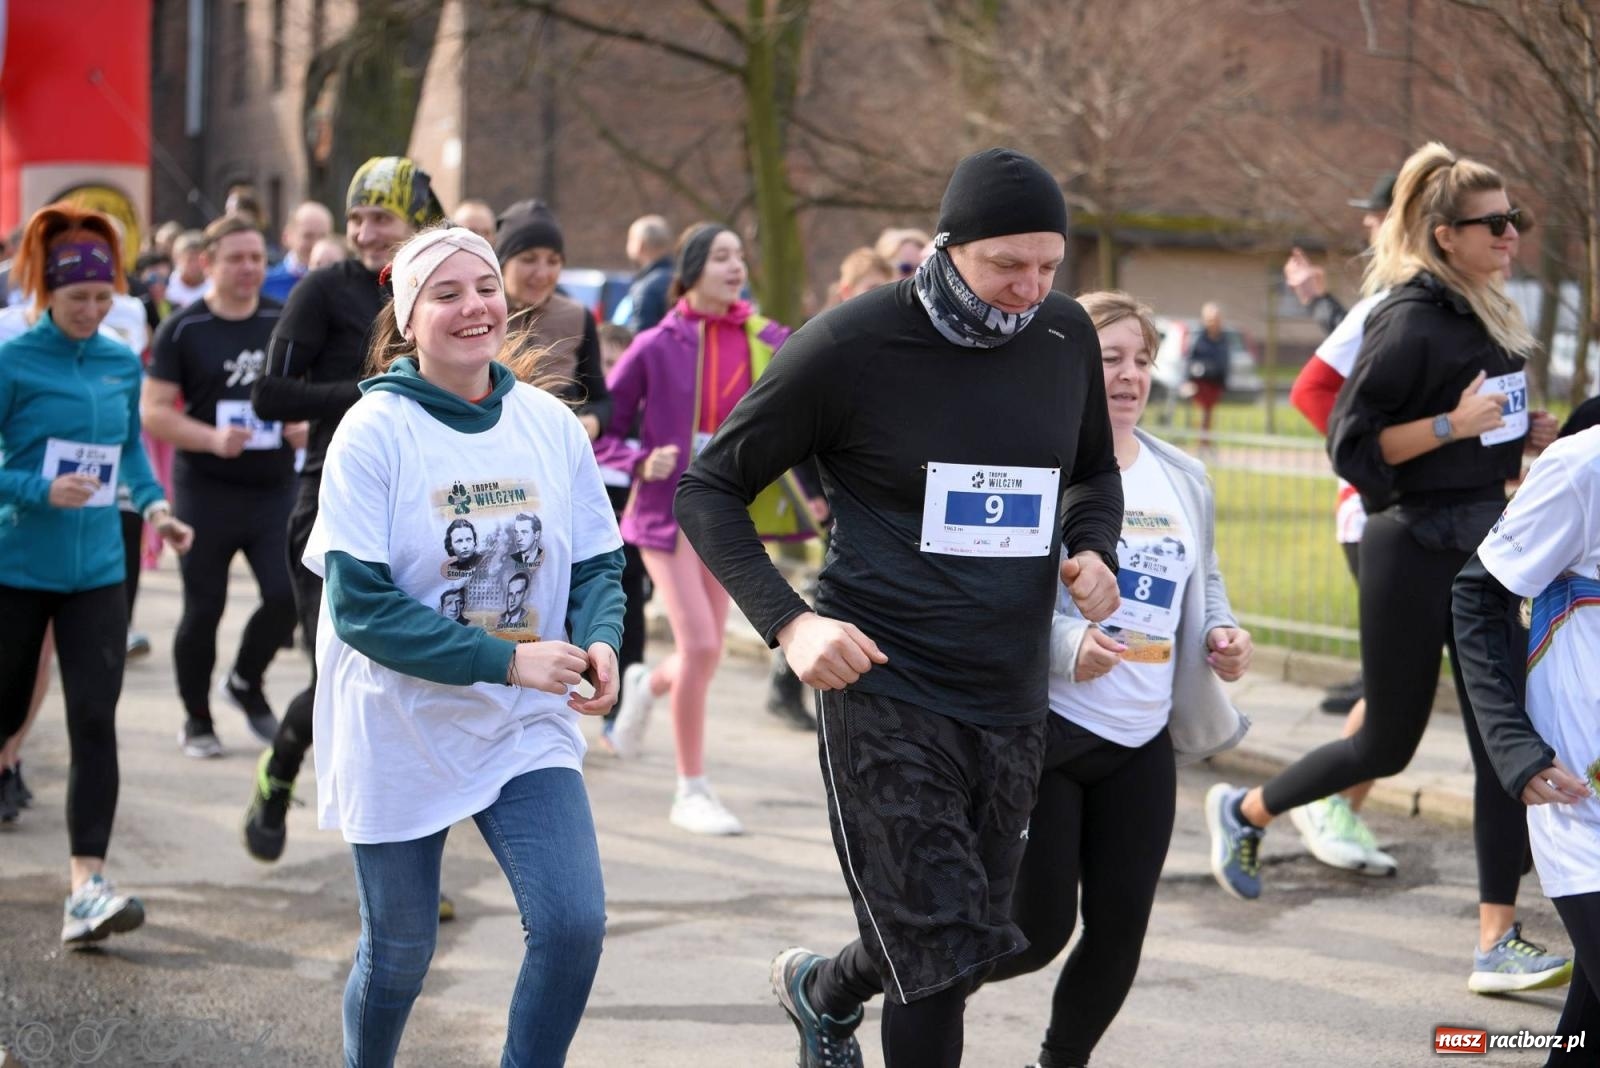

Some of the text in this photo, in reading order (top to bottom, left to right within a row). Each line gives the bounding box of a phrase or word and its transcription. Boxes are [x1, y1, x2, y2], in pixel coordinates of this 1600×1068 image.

[472, 482, 499, 492] TROPEM
[989, 478, 1023, 489] WILCZYM
[474, 488, 527, 506] WILCZYM
[985, 494, 1004, 524] 9
[1134, 575, 1153, 601] 8
